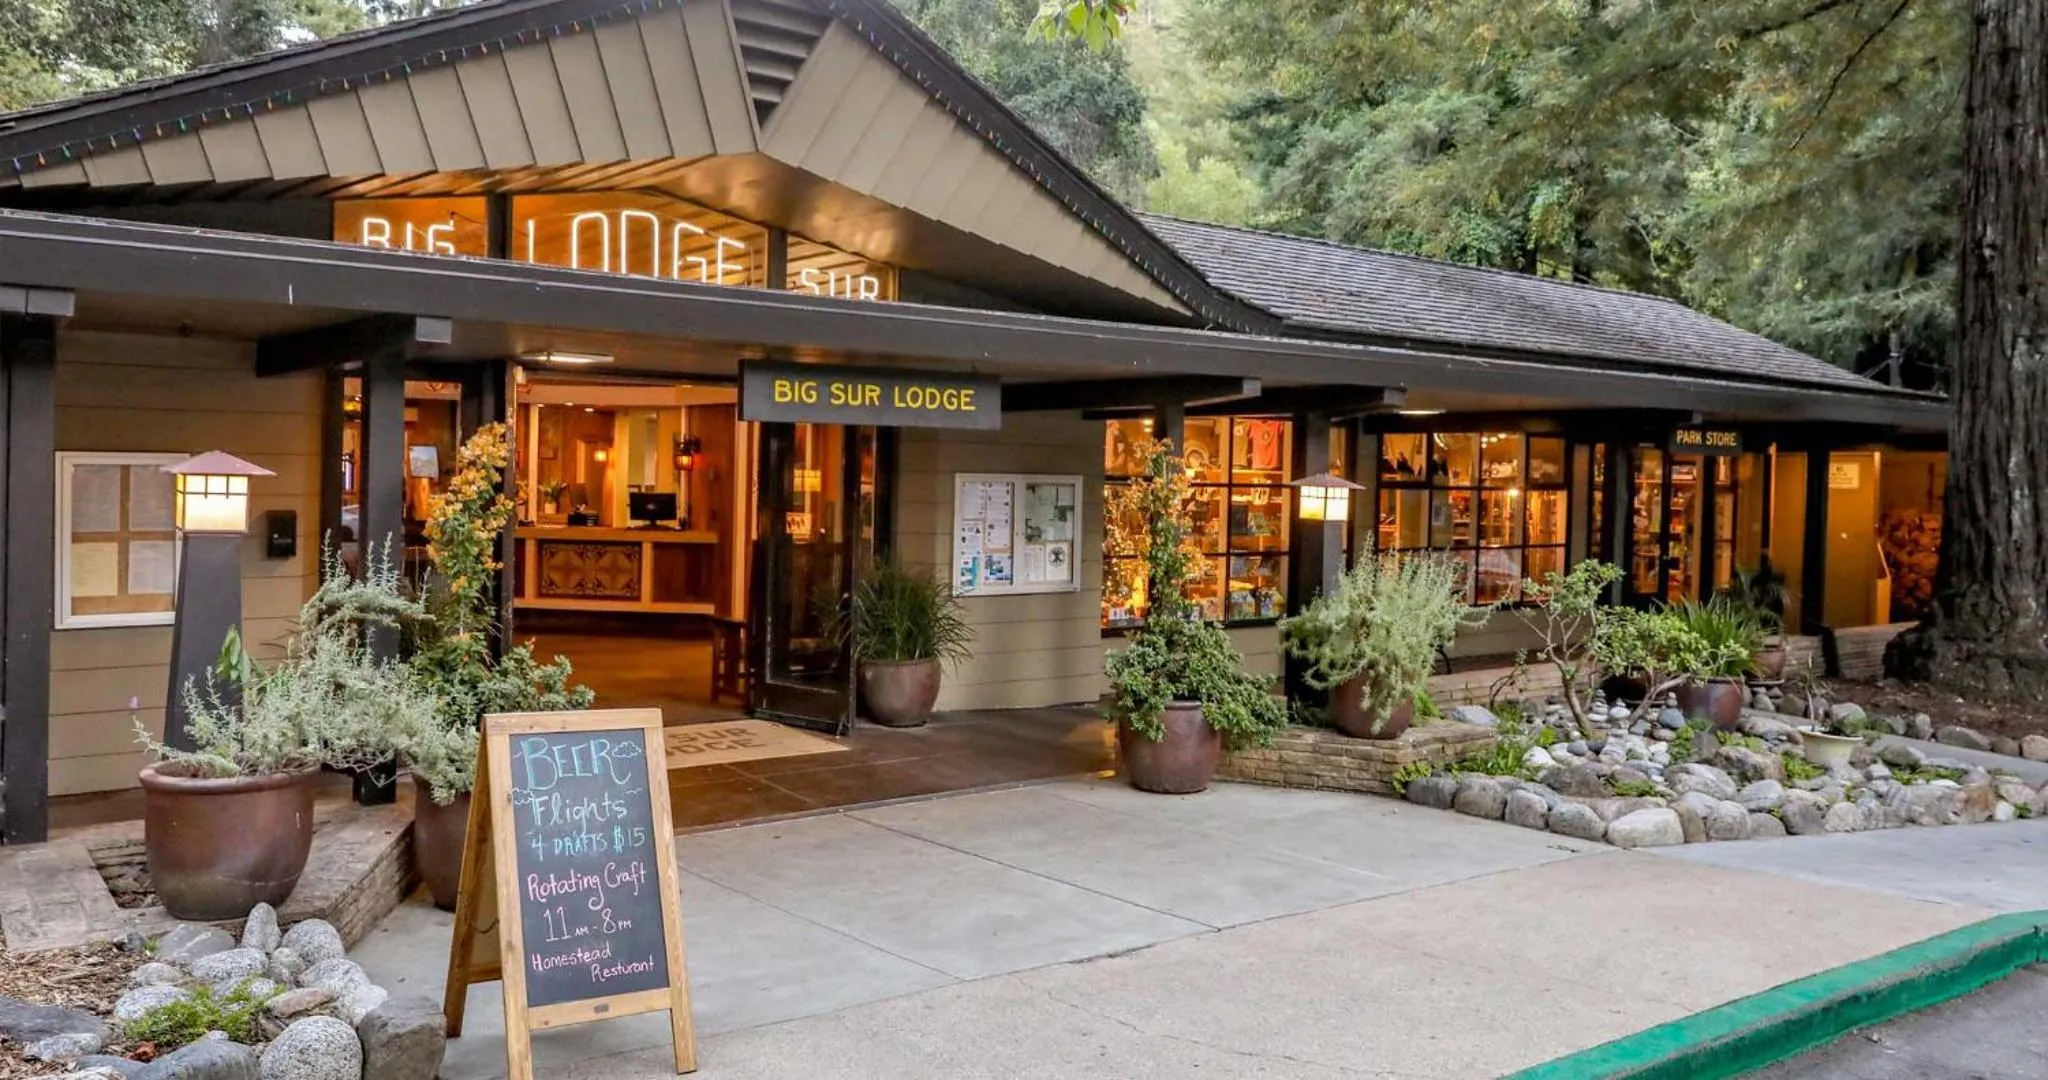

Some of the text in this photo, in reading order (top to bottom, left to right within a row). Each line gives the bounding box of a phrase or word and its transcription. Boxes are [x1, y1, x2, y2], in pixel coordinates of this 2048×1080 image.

[774, 379, 976, 411] BIG SUR LODGE
[1676, 429, 1738, 447] PARK STORE
[667, 728, 757, 744] SUR
[532, 792, 627, 835] Flights
[529, 825, 645, 860] 4 DRAFTS $15
[527, 861, 647, 911] Rotating Craft
[532, 941, 612, 972] Homestead
[591, 953, 654, 983] Resturant
